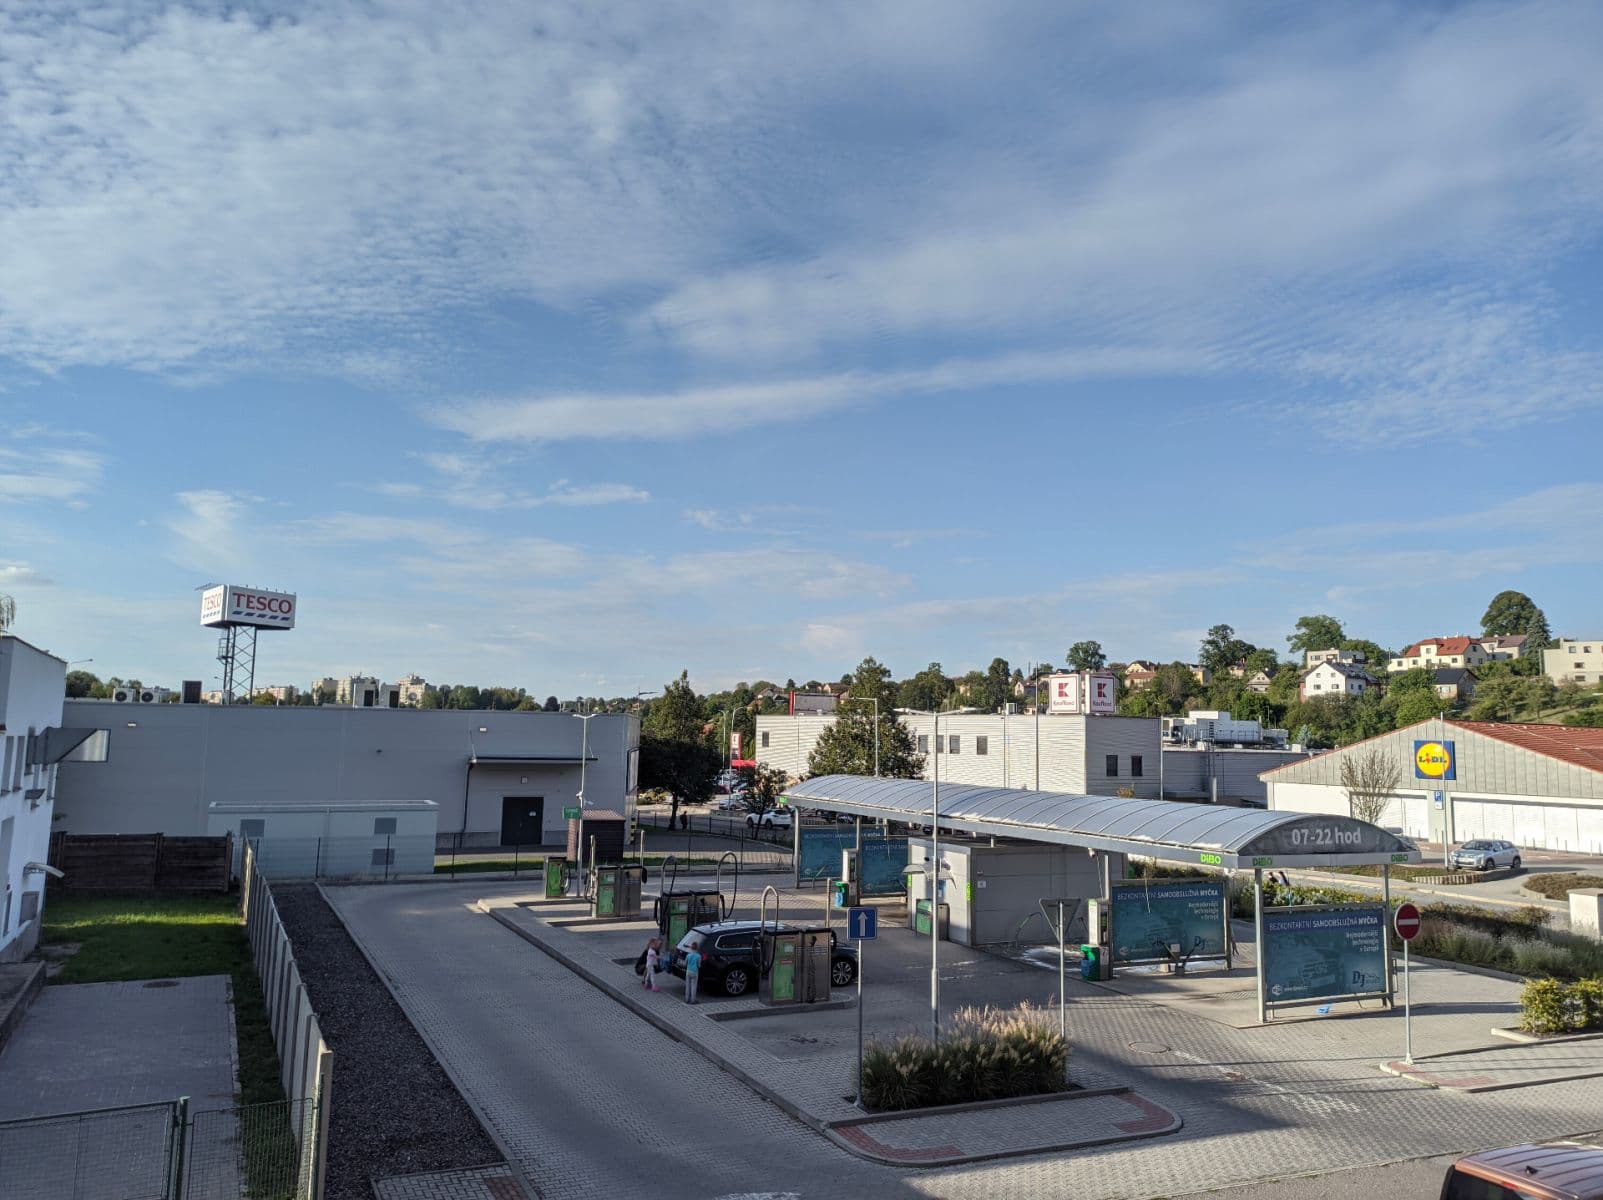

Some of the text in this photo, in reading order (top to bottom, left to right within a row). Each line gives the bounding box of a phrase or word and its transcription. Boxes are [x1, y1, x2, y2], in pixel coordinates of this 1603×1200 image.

[204, 593, 222, 612] TESCO
[232, 592, 292, 614] TESCO
[1292, 827, 1362, 845] 07-22 hod
